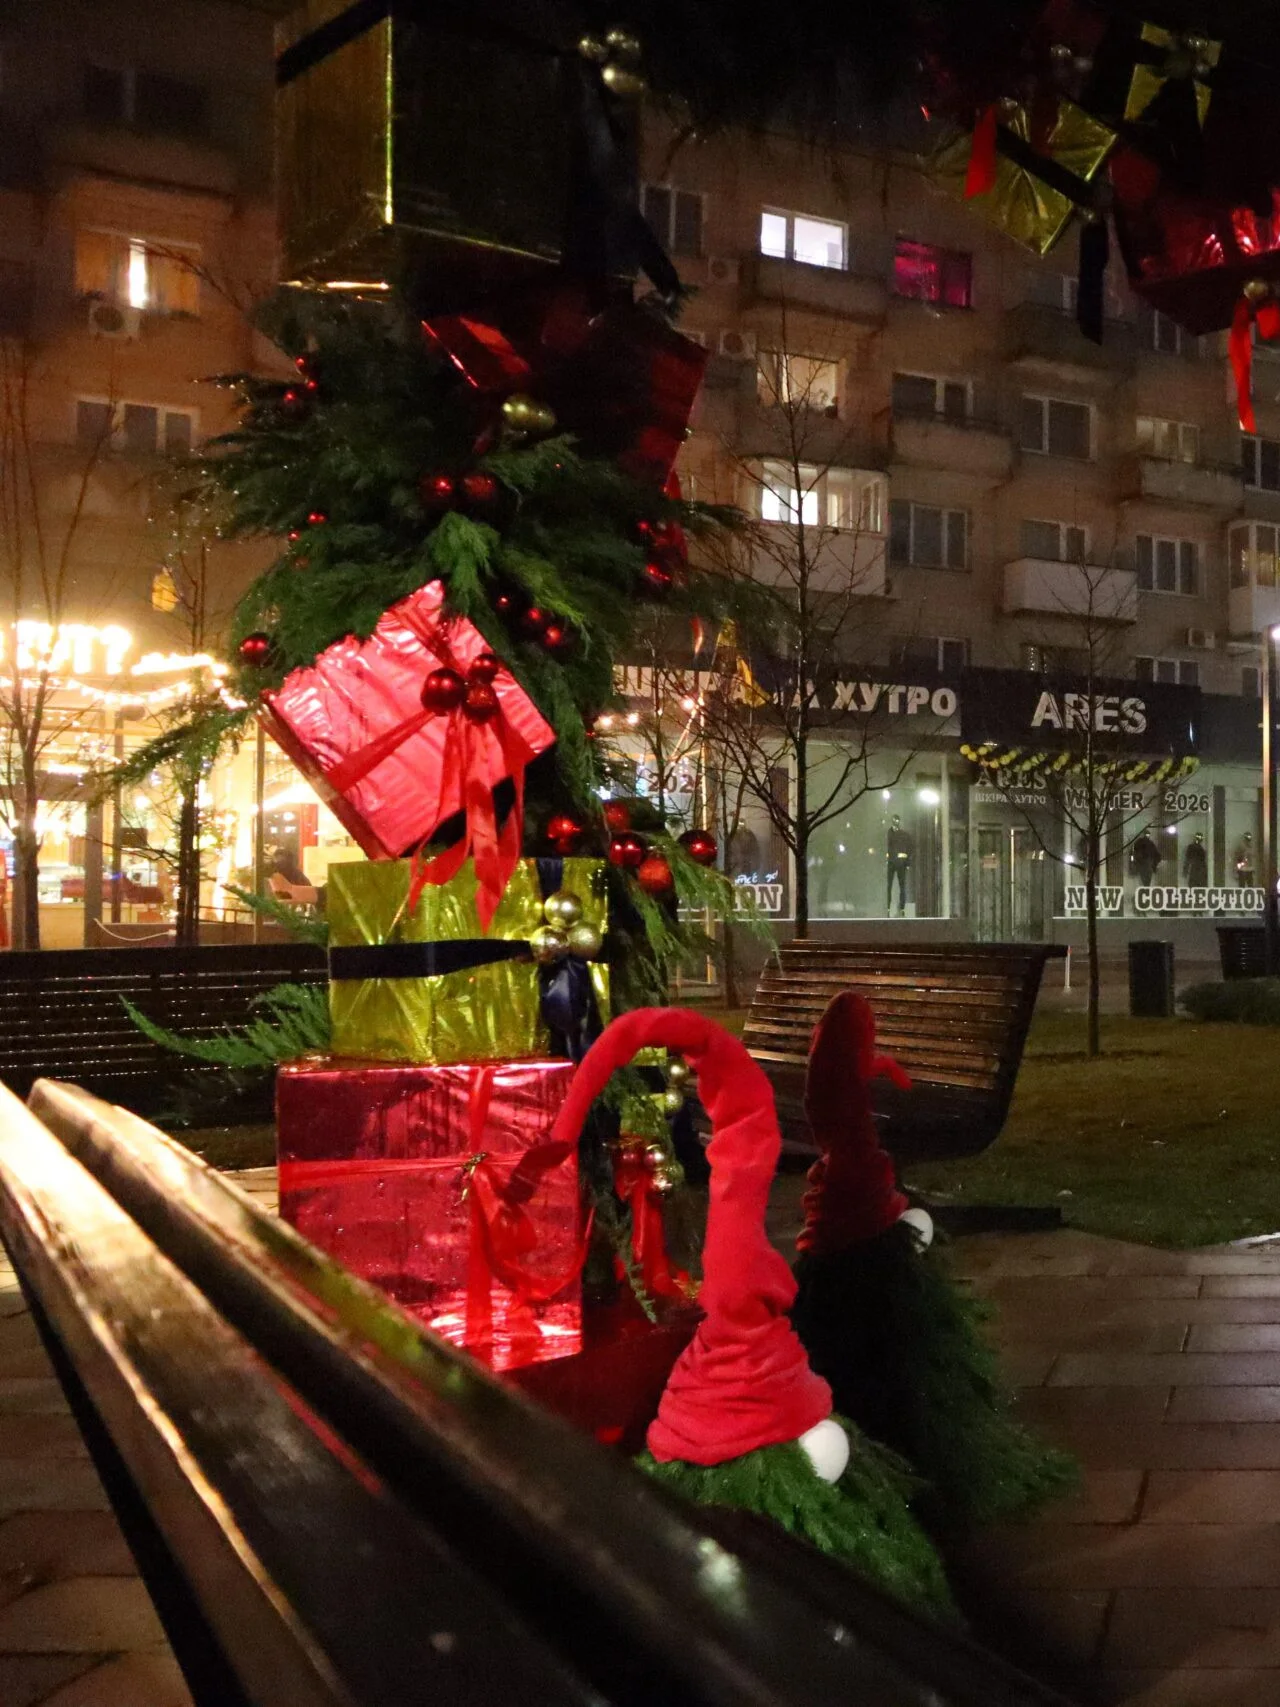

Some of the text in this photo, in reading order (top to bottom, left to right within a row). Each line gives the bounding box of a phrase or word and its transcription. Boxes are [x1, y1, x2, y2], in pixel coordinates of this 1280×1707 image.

[832, 681, 957, 717] ХУТРО
[1031, 691, 1147, 734] ARES
[648, 774, 703, 794] 202
[1165, 793, 1210, 812] 2026
[1064, 885, 1266, 911] NW COLLECTION
